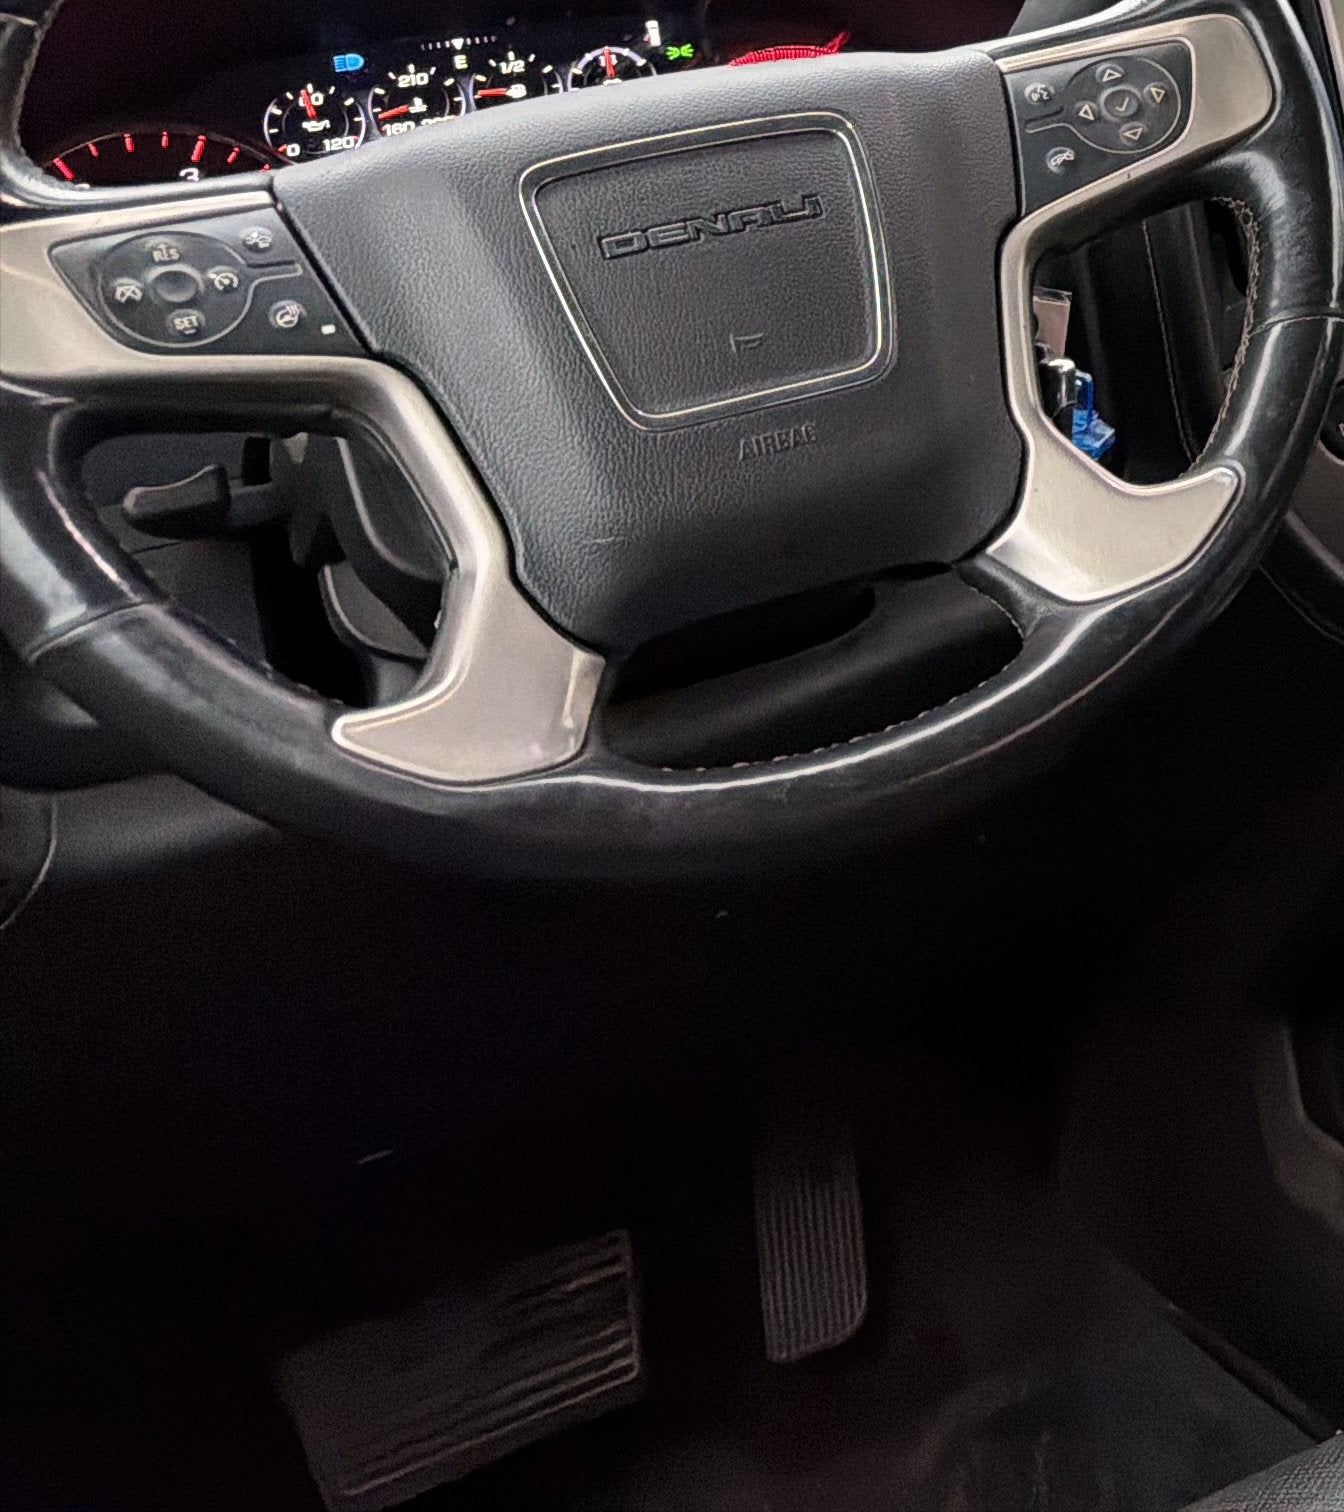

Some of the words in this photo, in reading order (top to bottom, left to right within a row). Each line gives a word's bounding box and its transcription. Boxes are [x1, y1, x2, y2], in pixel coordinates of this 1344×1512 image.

[455, 55, 469, 70] E
[500, 59, 526, 75] 1/2
[399, 72, 429, 88] 210
[286, 143, 300, 157] 0
[323, 136, 356, 152] 120
[597, 193, 825, 261] DENALI
[153, 248, 181, 263] RES
[173, 314, 199, 331] SET
[738, 421, 818, 461] AIRBAG
